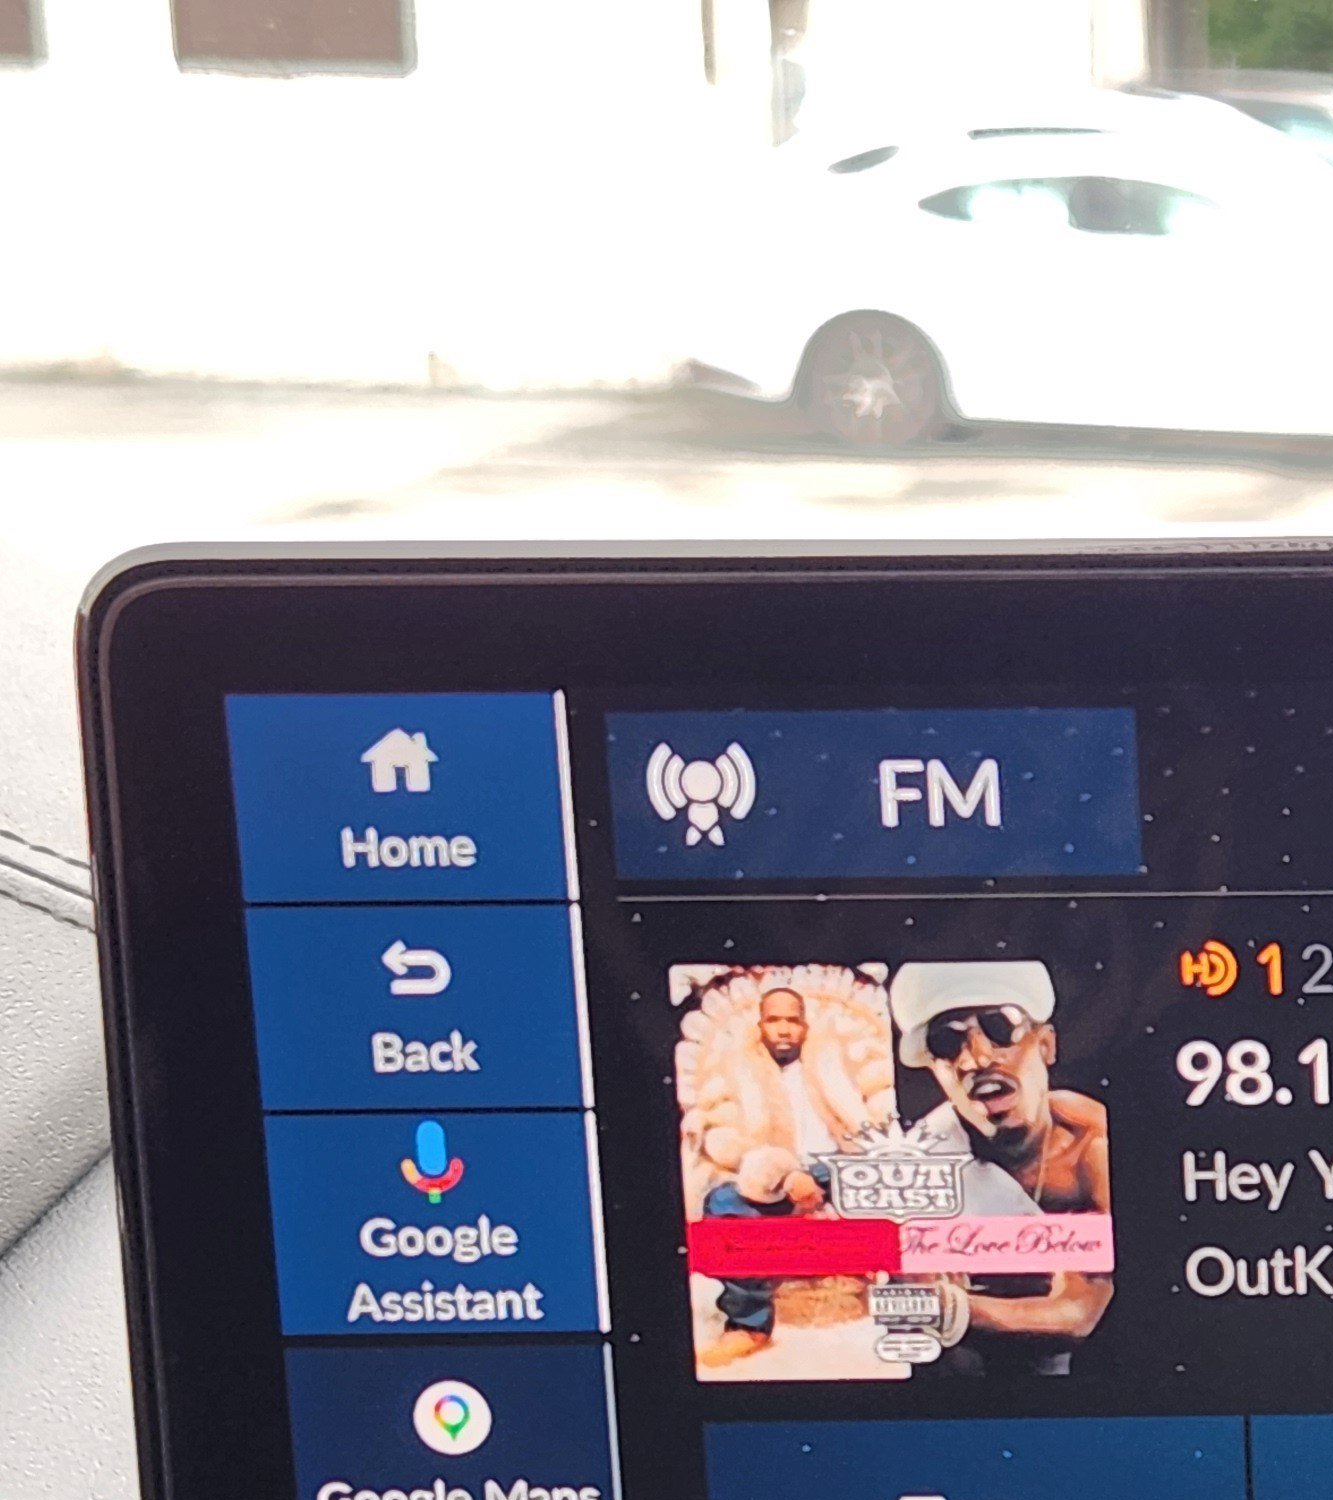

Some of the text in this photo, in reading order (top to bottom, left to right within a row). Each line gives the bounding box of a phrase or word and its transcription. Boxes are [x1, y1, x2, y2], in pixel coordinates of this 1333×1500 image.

[878, 757, 1005, 829] FM
[341, 828, 477, 870] Home
[370, 1031, 480, 1074] Back
[1175, 1038, 1333, 1109] 98.1
[840, 1161, 953, 1189] OUT
[1181, 1151, 1294, 1210] Hey
[842, 1188, 955, 1210] KAST
[359, 1217, 520, 1263] Google
[898, 1225, 940, 1255] The
[347, 1282, 544, 1323] Assistant
